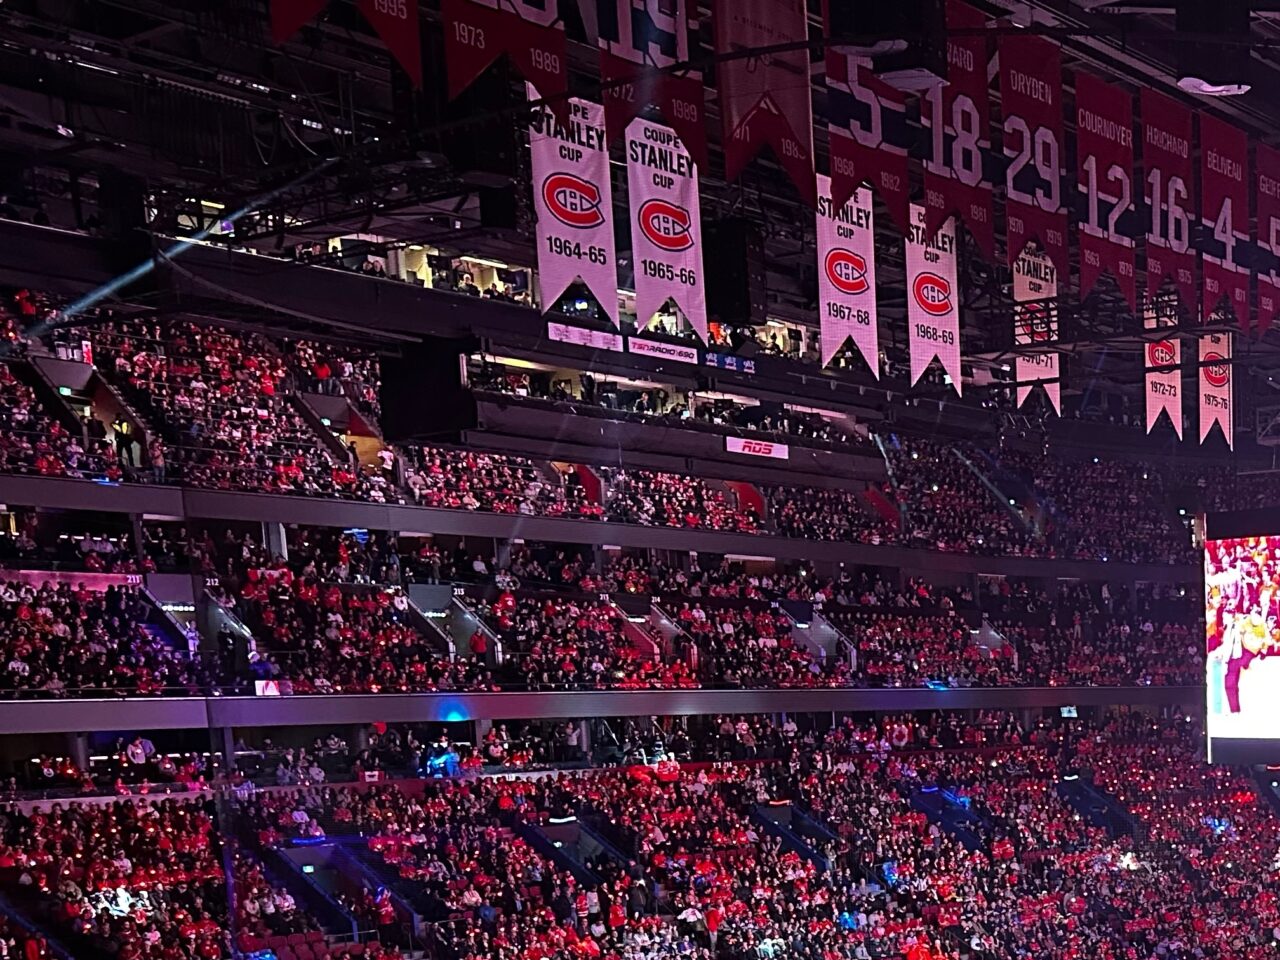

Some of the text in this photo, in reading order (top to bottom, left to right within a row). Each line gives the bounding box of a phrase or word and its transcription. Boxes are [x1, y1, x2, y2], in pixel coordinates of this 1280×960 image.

[452, 21, 486, 49] 1973
[529, 47, 560, 75] 1989
[1010, 69, 1052, 105] DRYDEN
[672, 98, 698, 122] 1989
[643, 127, 680, 149] COUPE
[922, 85, 983, 187] 18
[1078, 107, 1133, 149] COURNOYER
[559, 145, 583, 163] CUP
[629, 140, 696, 179] STANLEY
[781, 138, 807, 160] 198
[833, 156, 855, 178] 1968
[1003, 115, 1061, 213] 29
[1207, 148, 1242, 182] BÉLIVEAU
[653, 173, 675, 189] CUP
[880, 171, 901, 192] 1982
[926, 189, 945, 209] 1966
[1082, 154, 1133, 248] 12
[970, 204, 987, 223] 1981
[1147, 167, 1189, 254] 16
[837, 225, 854, 240] CUP
[1008, 216, 1024, 235] 1970
[1214, 197, 1237, 273] 4
[546, 236, 607, 265] 1964-65
[924, 250, 940, 264] CUP
[1083, 249, 1100, 268] 1963
[641, 259, 697, 286] 1965-66
[1015, 257, 1055, 284] STANLEY
[1028, 281, 1043, 293] CUP
[826, 302, 870, 326] 1967-68
[914, 323, 954, 345] 1968-69
[1150, 380, 1177, 397] 1972-73
[1203, 393, 1229, 410] 1975-76
[742, 441, 774, 455] RDS
[126, 574, 140, 583] 211
[205, 578, 220, 586] 212
[453, 587, 465, 596] 213
